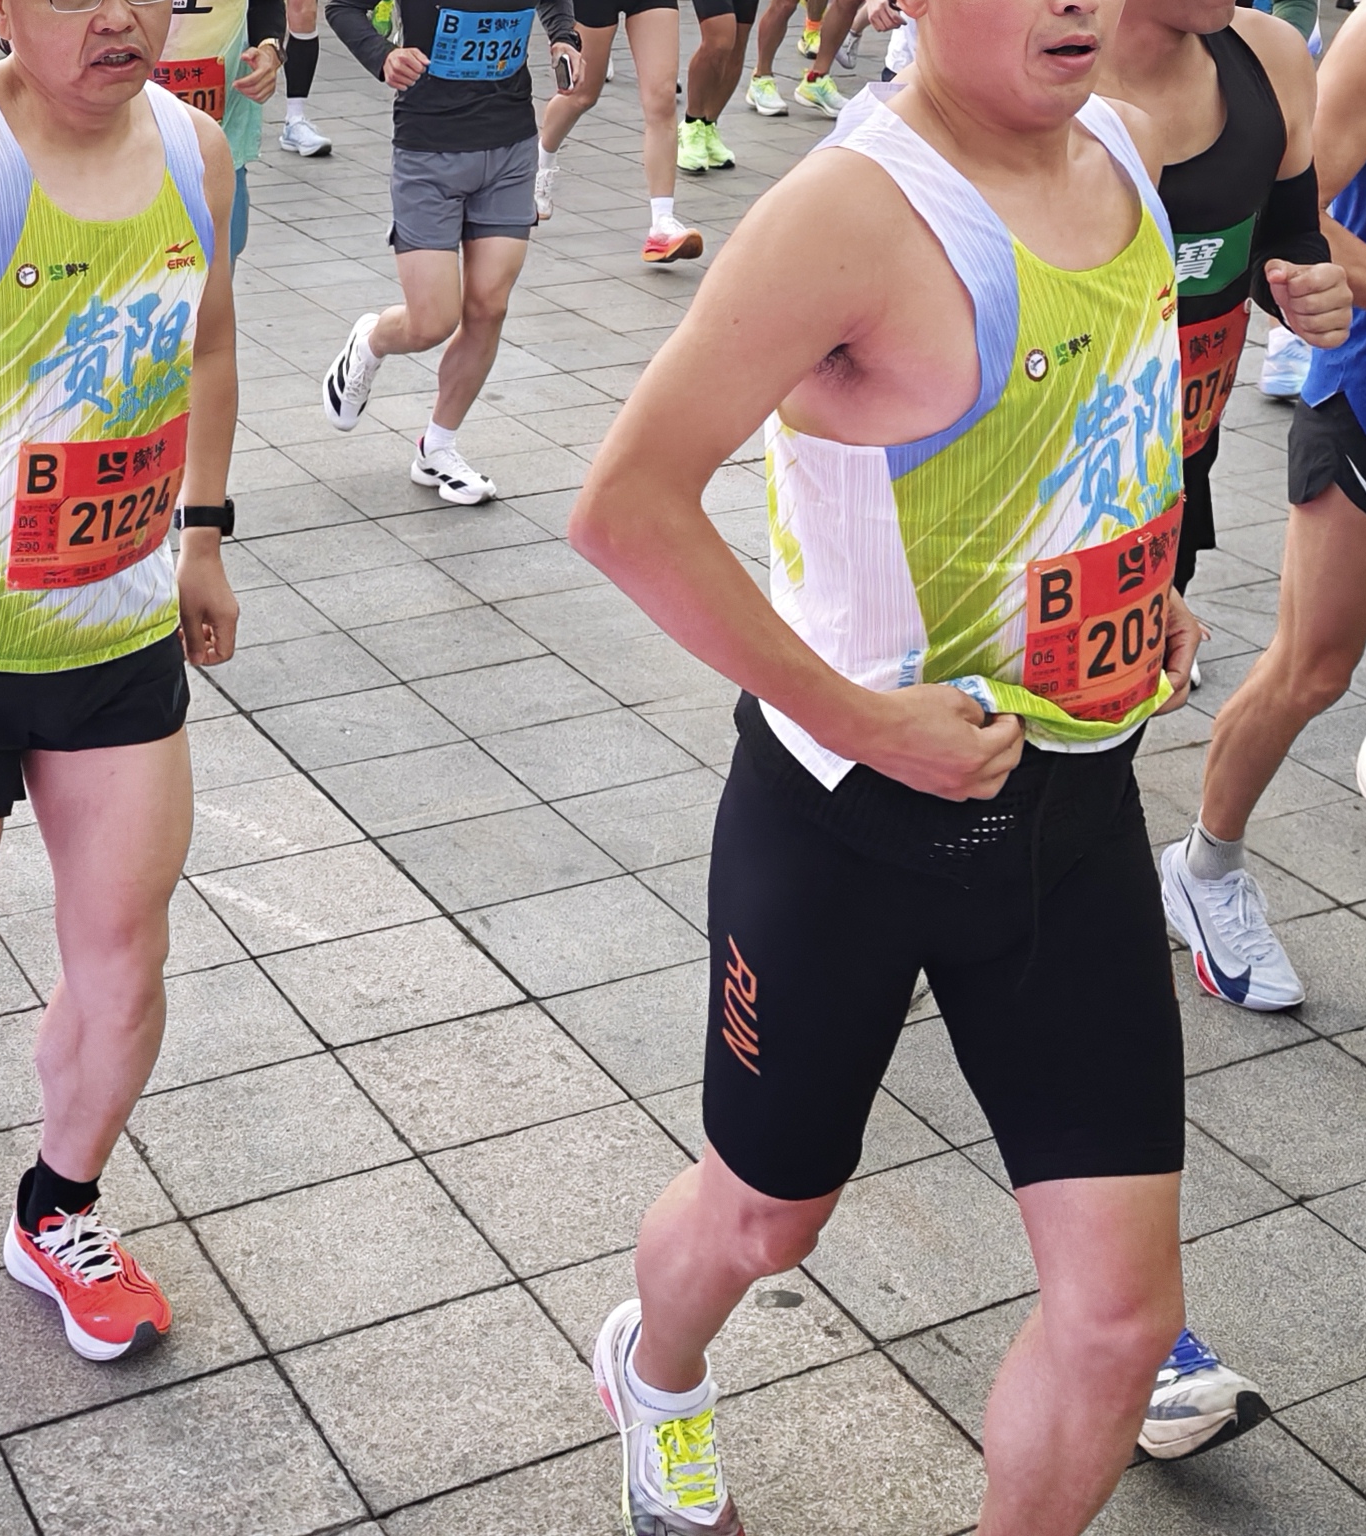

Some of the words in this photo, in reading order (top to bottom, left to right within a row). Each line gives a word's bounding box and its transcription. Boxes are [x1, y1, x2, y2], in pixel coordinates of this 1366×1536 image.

[442, 14, 460, 34] B
[460, 37, 522, 62] 21326
[166, 255, 197, 270] ERKE
[29, 292, 192, 416] 贵阳
[1067, 333, 1093, 358] 蒙牛
[27, 454, 58, 494] B
[68, 476, 171, 547] 21224
[1040, 569, 1074, 624] B
[1087, 595, 1165, 681] 203
[721, 933, 761, 1077] RUN
